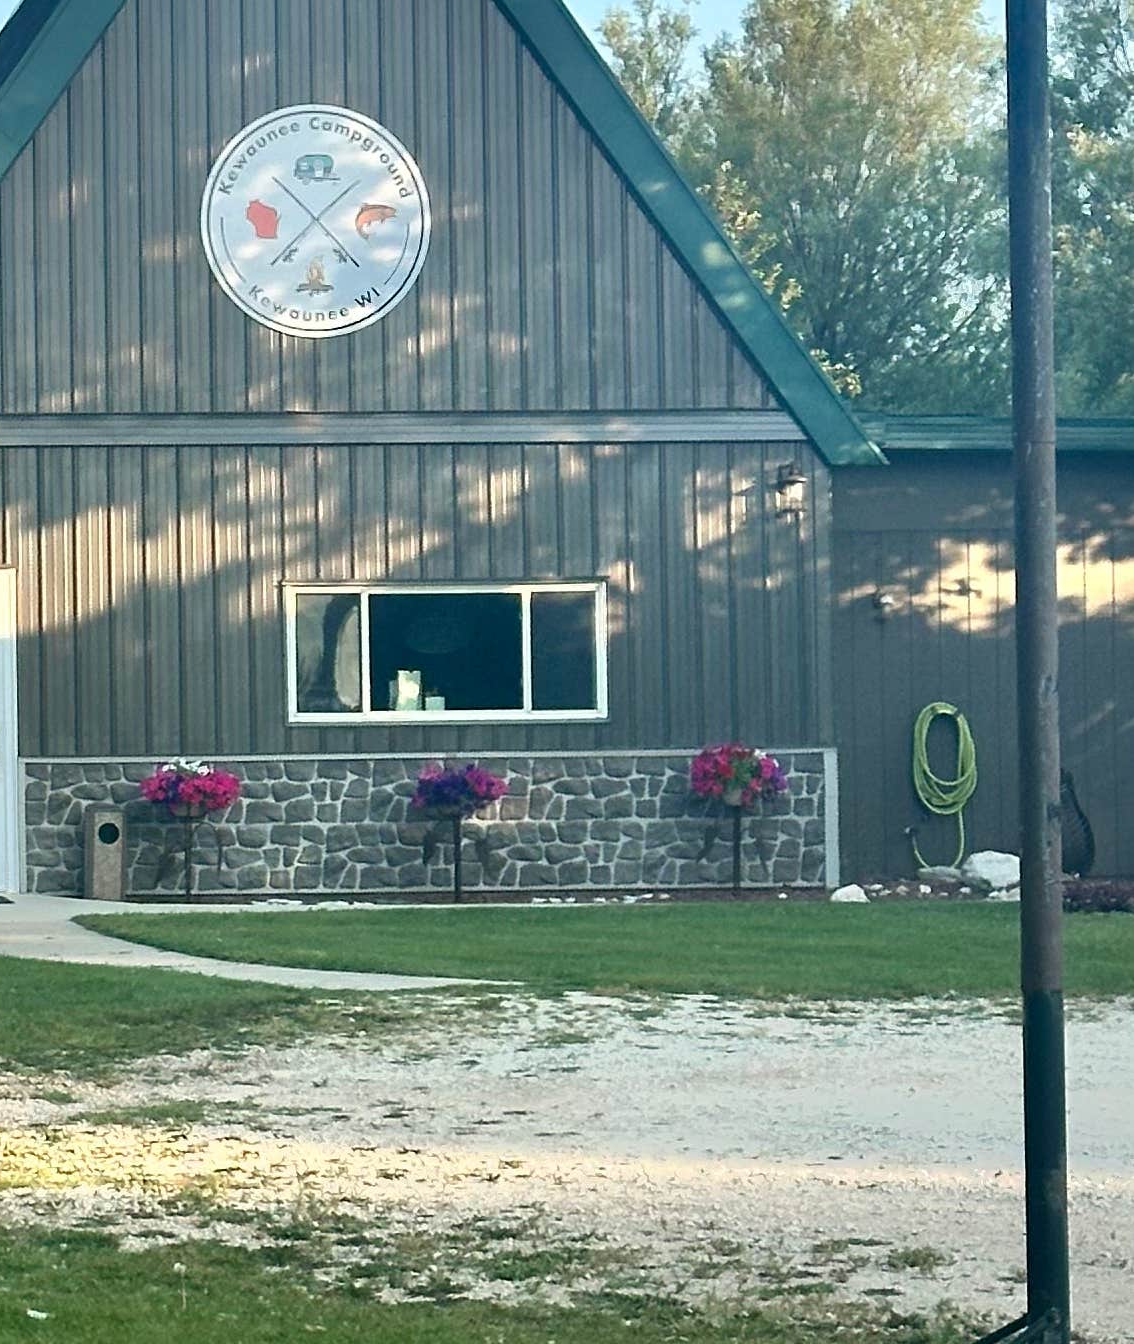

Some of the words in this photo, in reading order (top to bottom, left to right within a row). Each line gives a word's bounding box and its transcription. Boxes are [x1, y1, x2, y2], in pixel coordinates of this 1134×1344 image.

[218, 122, 300, 195] Kewaunee
[309, 117, 414, 198] Campground
[248, 285, 349, 321] Kewaunee
[354, 287, 380, 308] WI
